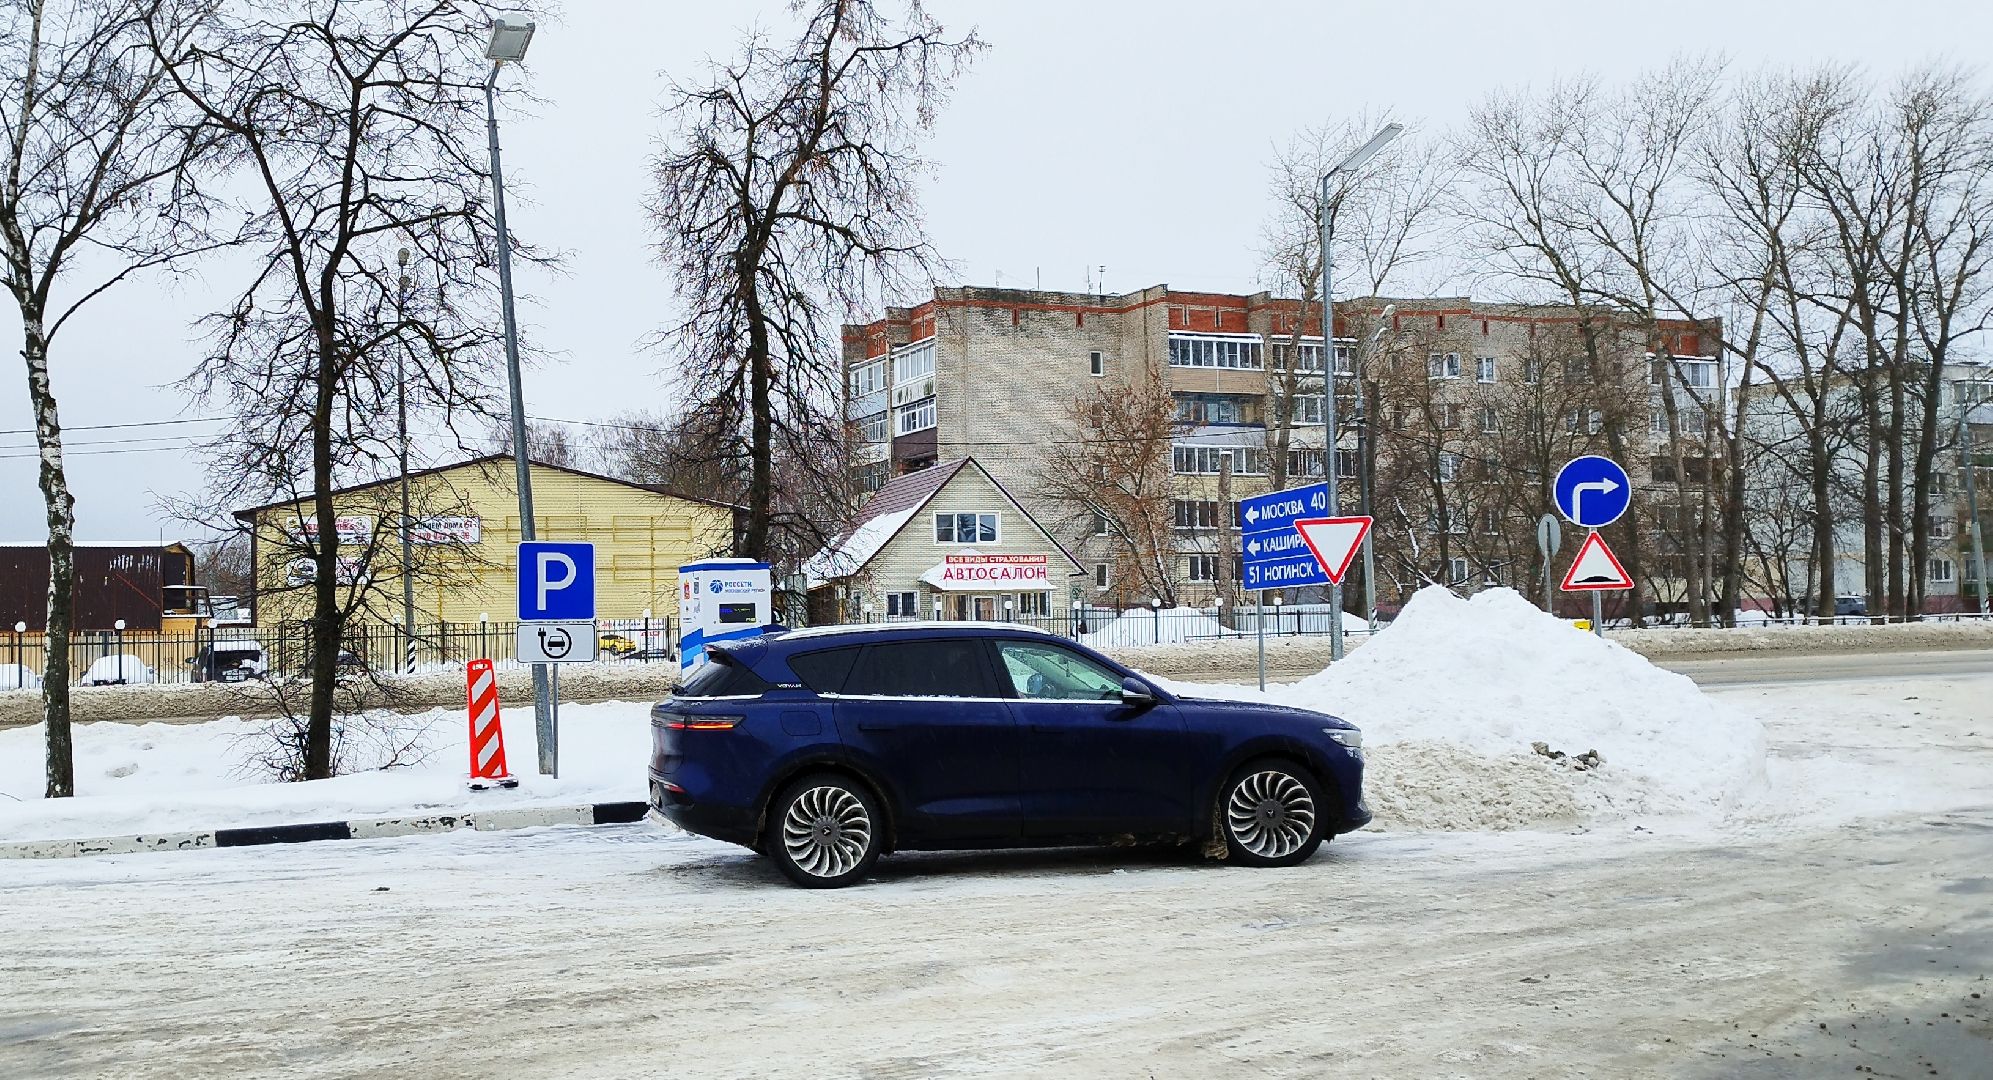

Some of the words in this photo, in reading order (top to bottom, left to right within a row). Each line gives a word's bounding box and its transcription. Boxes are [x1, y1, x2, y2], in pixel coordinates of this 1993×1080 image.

[1261, 499, 1306, 520] МОСКВА
[1310, 491, 1326, 511] 40
[948, 556, 963, 564] ВСЕ
[964, 556, 988, 564] ВИДЫ
[989, 555, 1045, 564] СТРАХОВАНИЯ
[537, 552, 577, 611] P
[943, 567, 1047, 580] АВТОСАЛОН
[1249, 566, 1260, 584] 51
[1264, 562, 1314, 581] НОГИНСК
